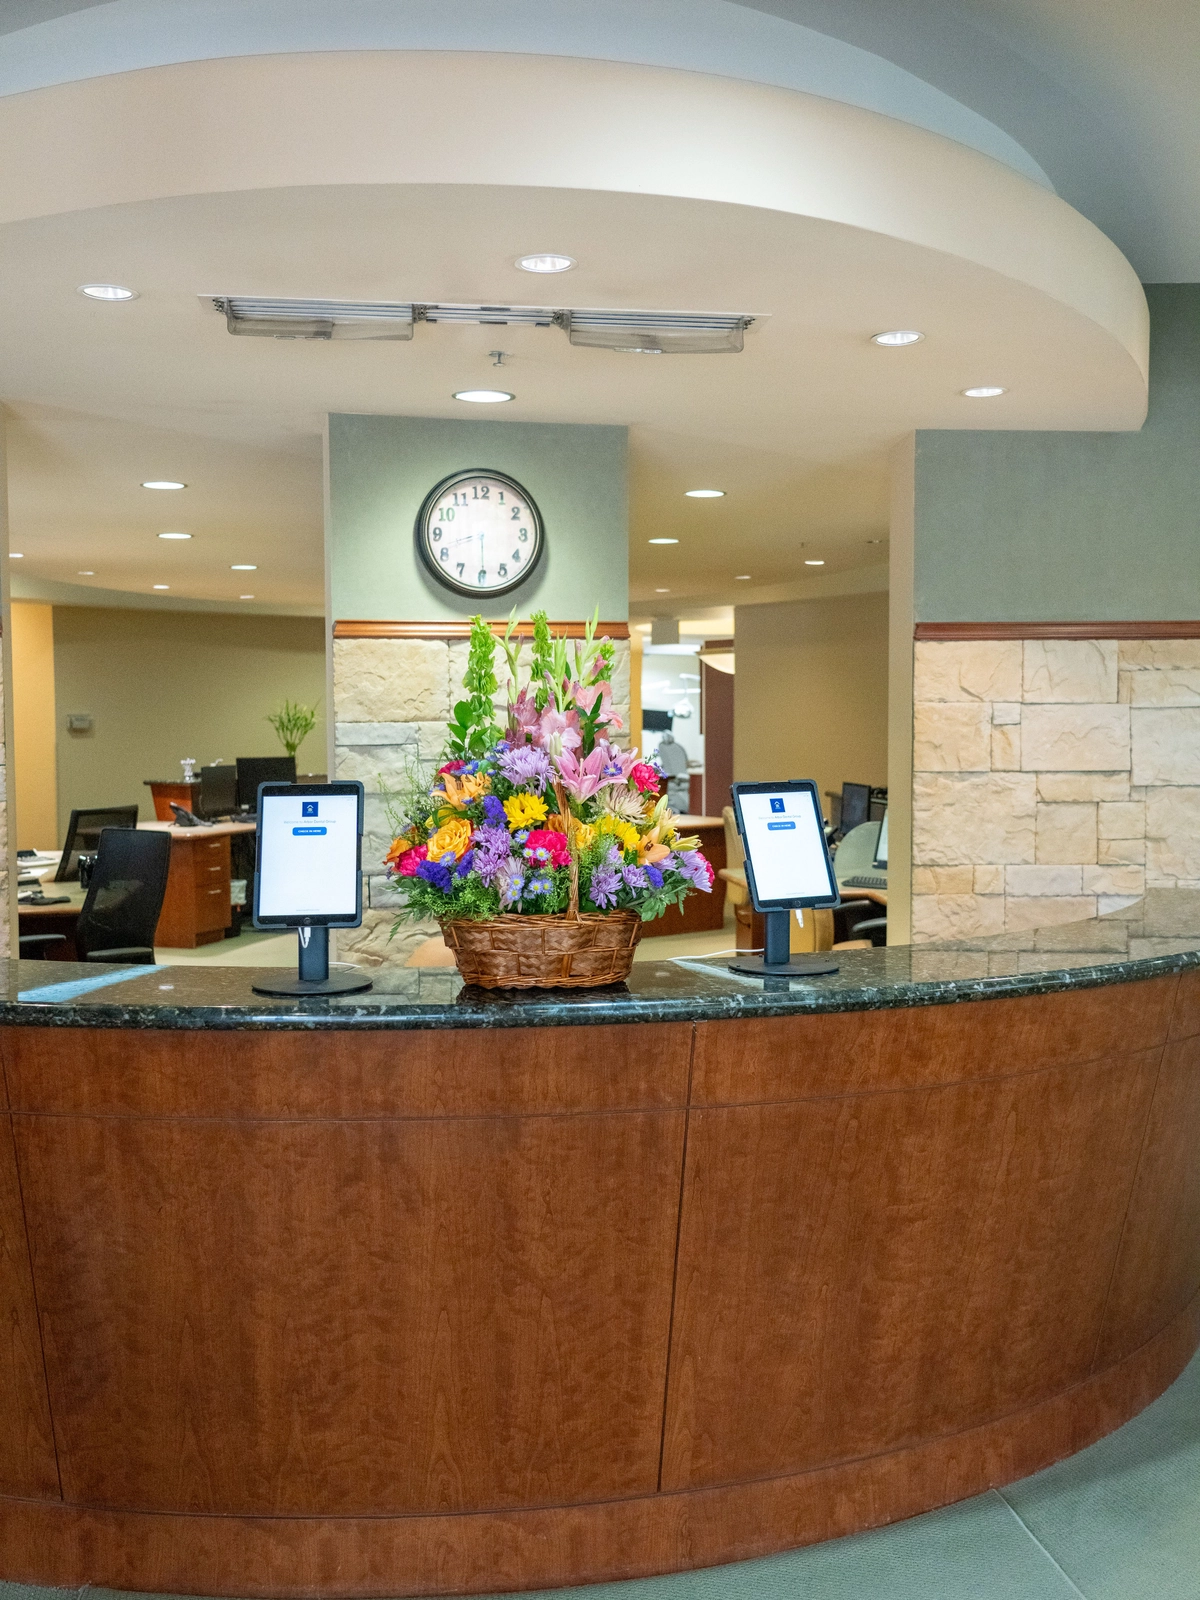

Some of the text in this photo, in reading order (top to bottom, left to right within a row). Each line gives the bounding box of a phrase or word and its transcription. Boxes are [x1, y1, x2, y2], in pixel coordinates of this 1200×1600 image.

[452, 492, 468, 506] 11
[472, 485, 490, 500] 12
[498, 491, 506, 505] 1
[438, 507, 455, 522] 10
[511, 506, 520, 520] 2
[432, 527, 442, 541] 9
[518, 527, 528, 542] 3
[440, 547, 449, 562] 8
[511, 548, 520, 563] 4
[456, 562, 465, 577] 7
[497, 563, 508, 578] 5
